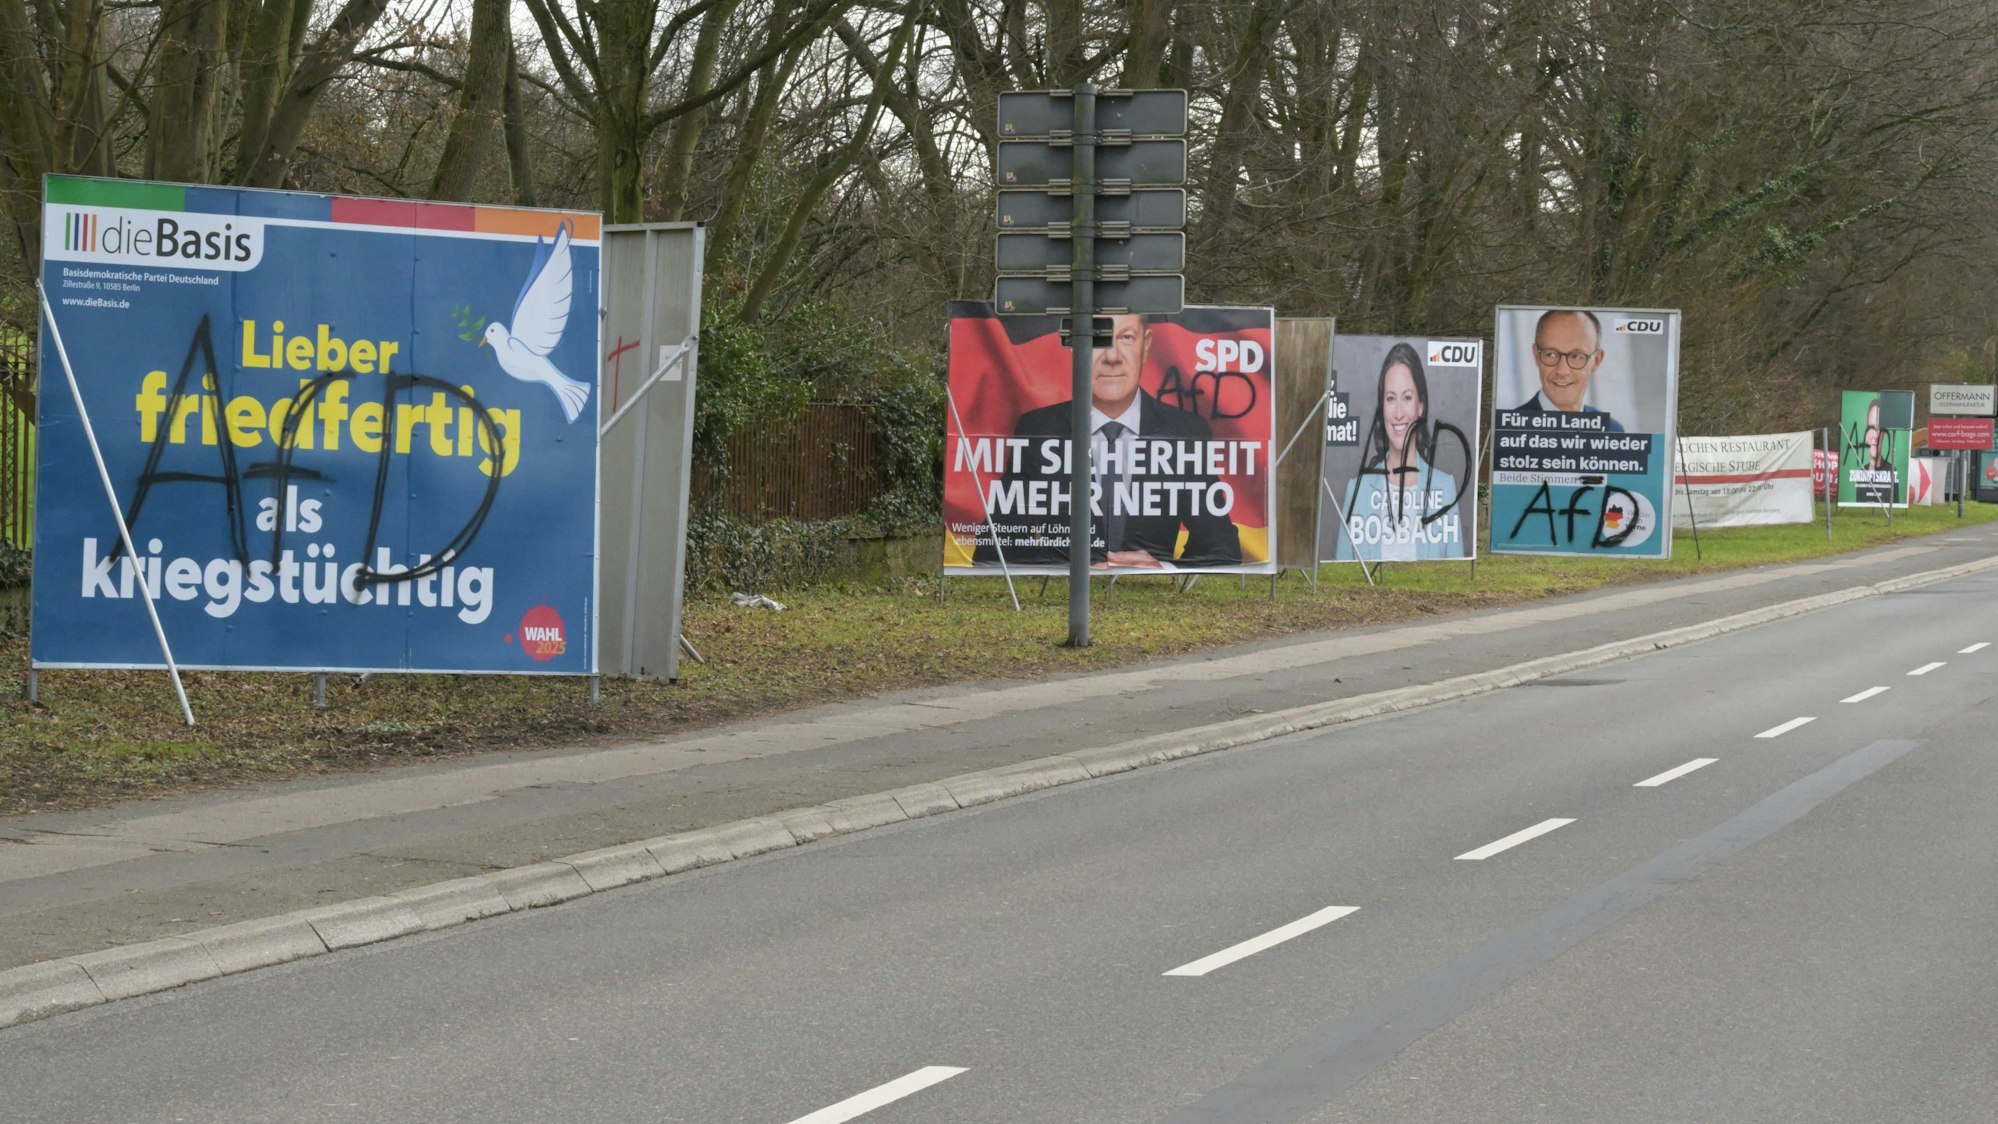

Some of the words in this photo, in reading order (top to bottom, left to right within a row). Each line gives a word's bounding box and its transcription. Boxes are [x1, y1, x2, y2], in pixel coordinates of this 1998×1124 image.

[102, 216, 251, 262] dieBasis
[62, 279, 94, 289] Zillestraße
[95, 282, 102, 290] 9,
[103, 282, 122, 291] 10585
[122, 283, 141, 292] Berlin
[63, 267, 143, 281] Basisdemokratische
[144, 273, 168, 283] Partei
[169, 274, 219, 286] Deutschland
[62, 297, 130, 309] www.dieBasis.de
[1627, 321, 1661, 332] CDU
[242, 320, 399, 374] Lieber
[1195, 338, 1264, 374] SPD
[1440, 346, 1476, 363] CDU
[1156, 365, 1256, 420] AfD
[1934, 391, 1990, 401] OFFERMANN
[136, 370, 521, 478] friedfertig
[1501, 412, 1528, 427] Für
[1532, 413, 1557, 428] ein
[1561, 415, 1606, 432] Land,
[107, 314, 505, 590] AfD
[1500, 434, 1527, 448] auf
[1529, 434, 1558, 449] das
[1561, 435, 1588, 449] wir
[1590, 436, 1648, 451] wieder
[1720, 438, 1791, 453] RESTAURANT
[1843, 421, 1891, 468] AfD
[953, 437, 1030, 474] MIT
[1040, 437, 1262, 476] SIHERHEIT
[1499, 455, 1539, 468] stolz
[1542, 455, 1576, 470] sein
[1579, 456, 1644, 471] können.
[1346, 406, 1472, 532] AfD
[1728, 460, 1761, 473] STUBE
[1849, 469, 1899, 483] ZUKUNFTSKRAT.
[1499, 473, 1529, 483] Beide
[1530, 474, 1577, 484] Stimmen
[986, 479, 1104, 517] MEHR
[1113, 481, 1235, 517] NETTO
[1370, 490, 1443, 510] CAROLINE
[256, 485, 323, 533] als
[1509, 479, 1639, 549] AfD
[952, 522, 989, 536] Weniger
[993, 522, 1028, 533] Steuern
[1030, 523, 1046, 534] auf
[1048, 523, 1071, 534] Löhn
[1350, 514, 1459, 546] BOSBACH
[953, 536, 1013, 546] ebensmitel:
[1014, 537, 1105, 548] mehrfürdich.de
[81, 537, 494, 625] kriegstüchtig
[524, 626, 563, 642] WAHL
[536, 641, 567, 655] 2025
